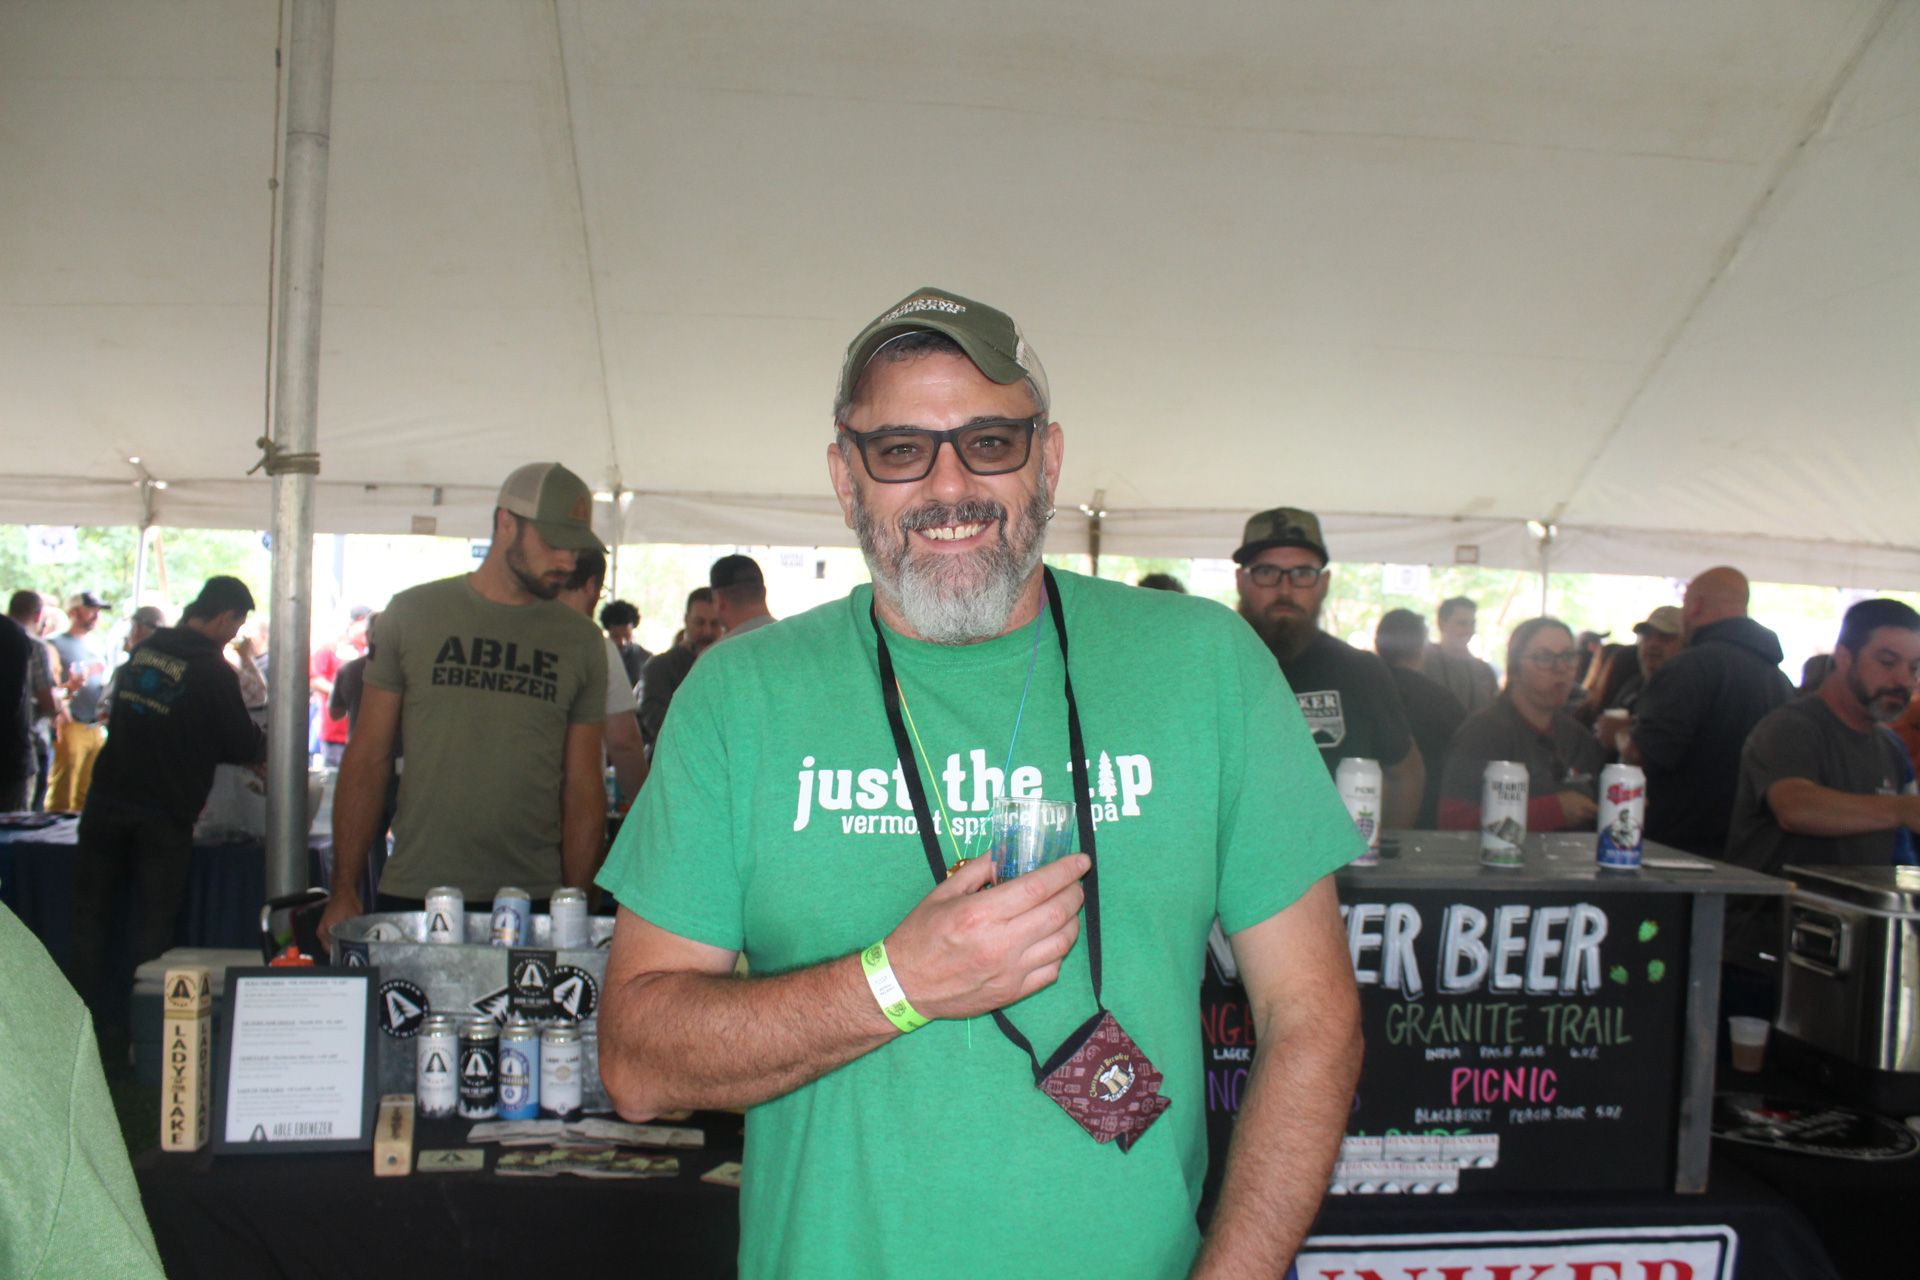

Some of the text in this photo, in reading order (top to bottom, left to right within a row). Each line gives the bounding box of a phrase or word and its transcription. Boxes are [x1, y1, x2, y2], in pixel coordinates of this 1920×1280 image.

[434, 635, 559, 683] ABLE
[431, 666, 558, 704] EBENEZER
[942, 749, 1043, 812] the
[841, 810, 942, 835] vermot
[1437, 902, 1609, 997] BEER
[1386, 1002, 1633, 1046] GRANITE TRAIL
[171, 1025, 187, 1077] LADY
[1213, 1048, 1250, 1062] LAGER
[1451, 1067, 1558, 1105] PICNIC
[170, 1093, 185, 1145] LAKE
[295, 1120, 333, 1136] EBENEZER
